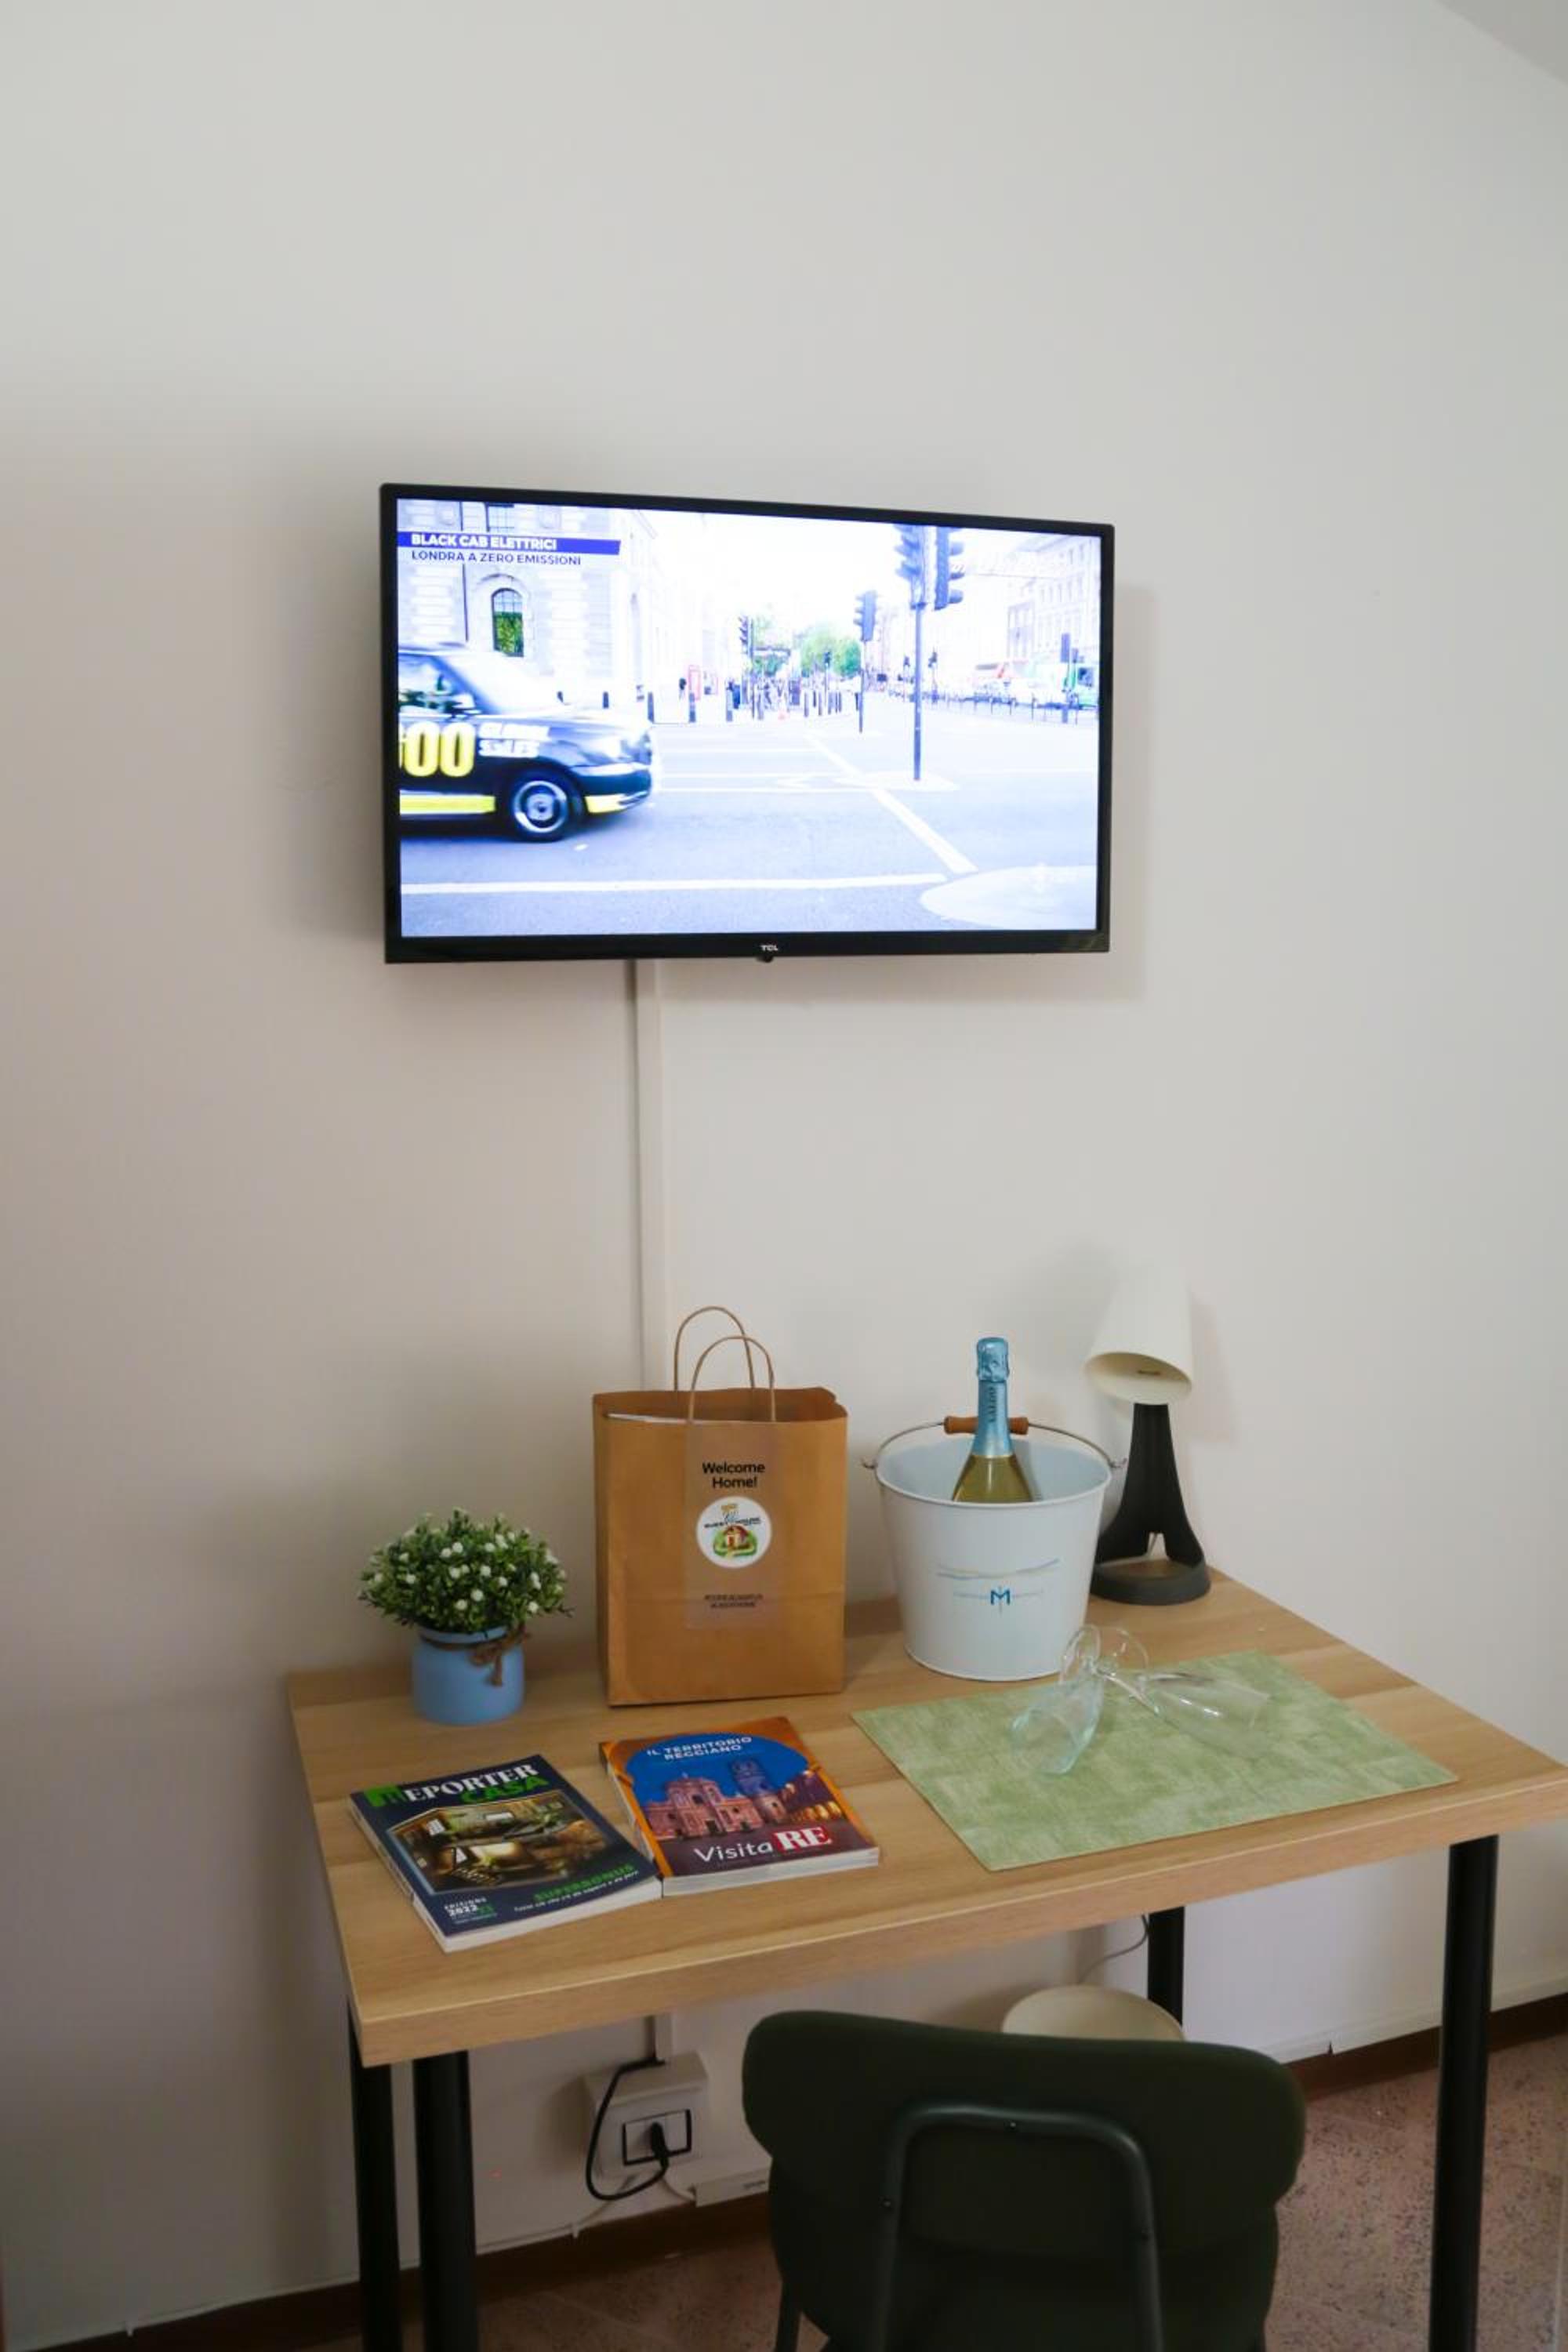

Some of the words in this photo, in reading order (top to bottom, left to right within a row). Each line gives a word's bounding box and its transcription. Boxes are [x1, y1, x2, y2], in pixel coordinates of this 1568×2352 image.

[410, 534, 457, 546] BLACK
[458, 536, 488, 548] CAB
[490, 537, 557, 551] ELETTRICI
[411, 550, 465, 561] LONDRA
[468, 554, 477, 562] A
[479, 553, 514, 563] ZERO
[517, 554, 581, 565] EMISSIONI
[399, 721, 475, 777] 00
[702, 1461, 765, 1474] Welcome
[712, 1477, 757, 1489] Home!
[664, 1737, 752, 1754] TERRITORIO
[664, 1744, 742, 1760] REGGIANO
[694, 1842, 773, 1862] Visita
[774, 1827, 832, 1851] RE
